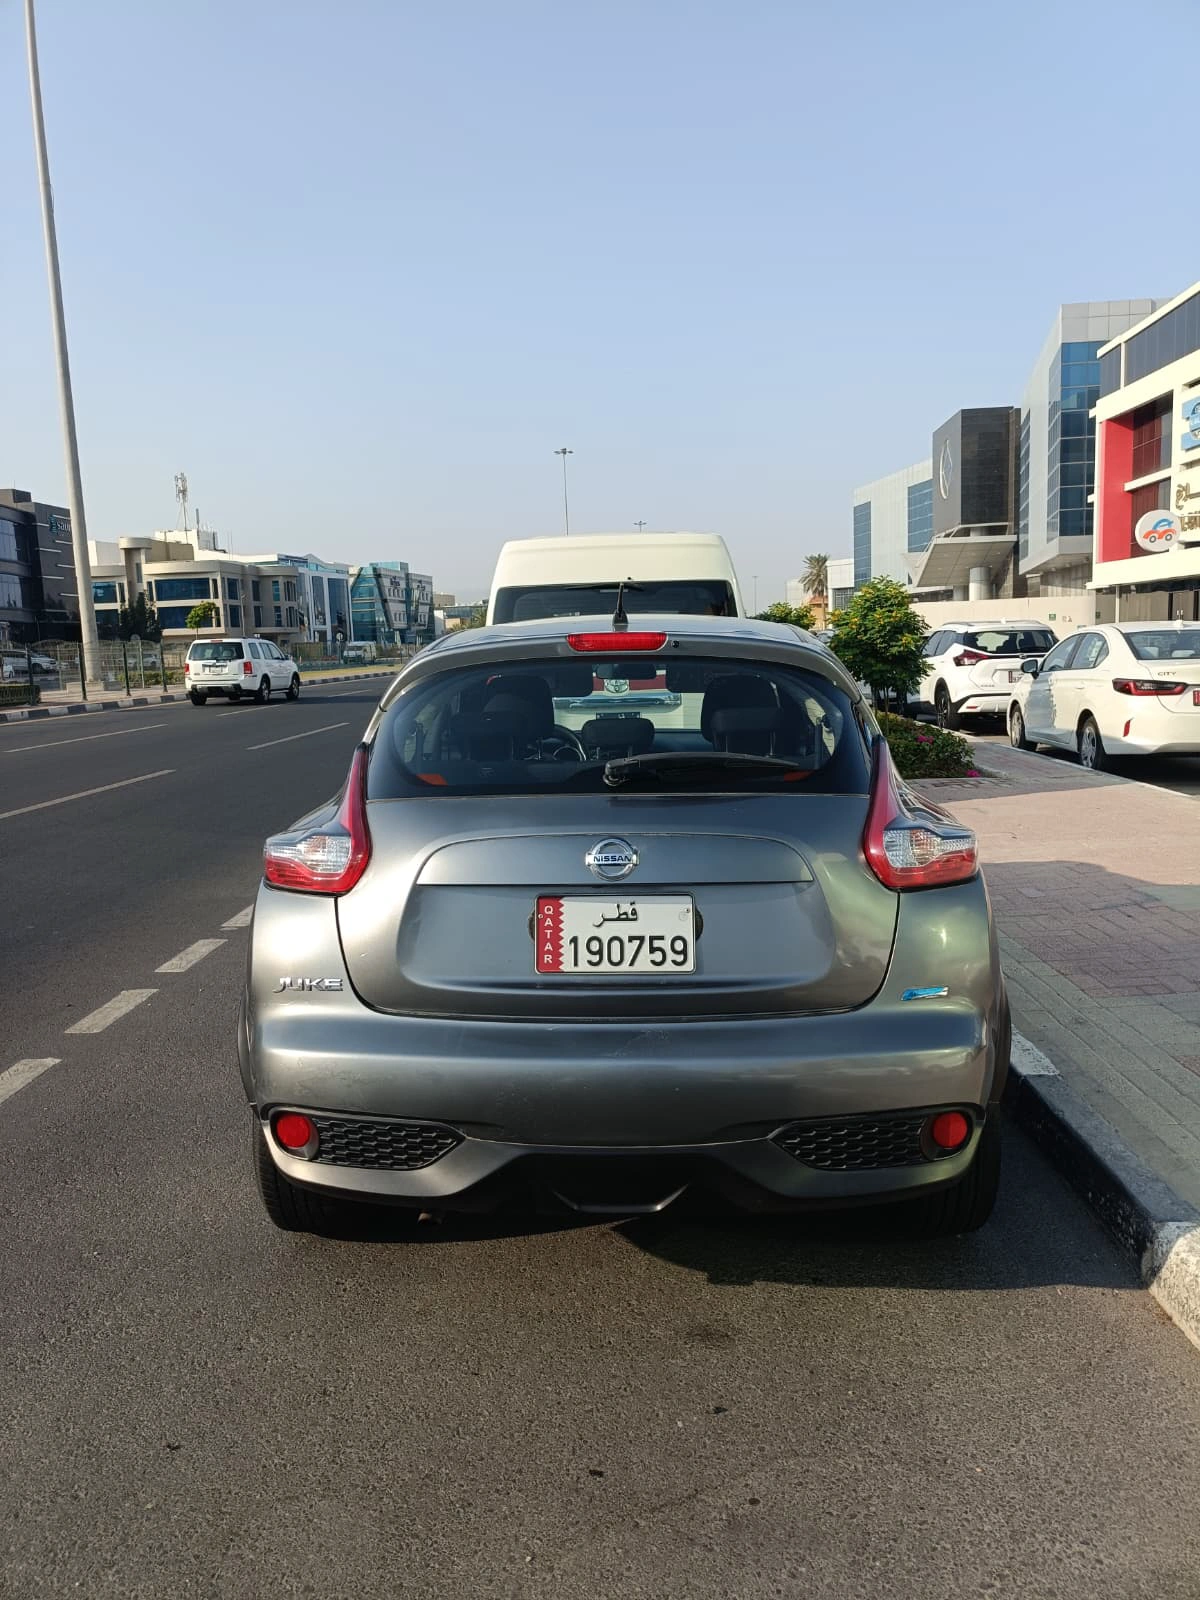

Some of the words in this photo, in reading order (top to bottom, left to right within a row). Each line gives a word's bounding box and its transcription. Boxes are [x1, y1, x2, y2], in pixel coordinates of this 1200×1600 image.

[593, 855, 632, 863] NISSAN
[593, 900, 638, 928] قطر
[544, 905, 554, 964] QATAR
[568, 935, 688, 967] 190759
[272, 977, 344, 994] JUKE
